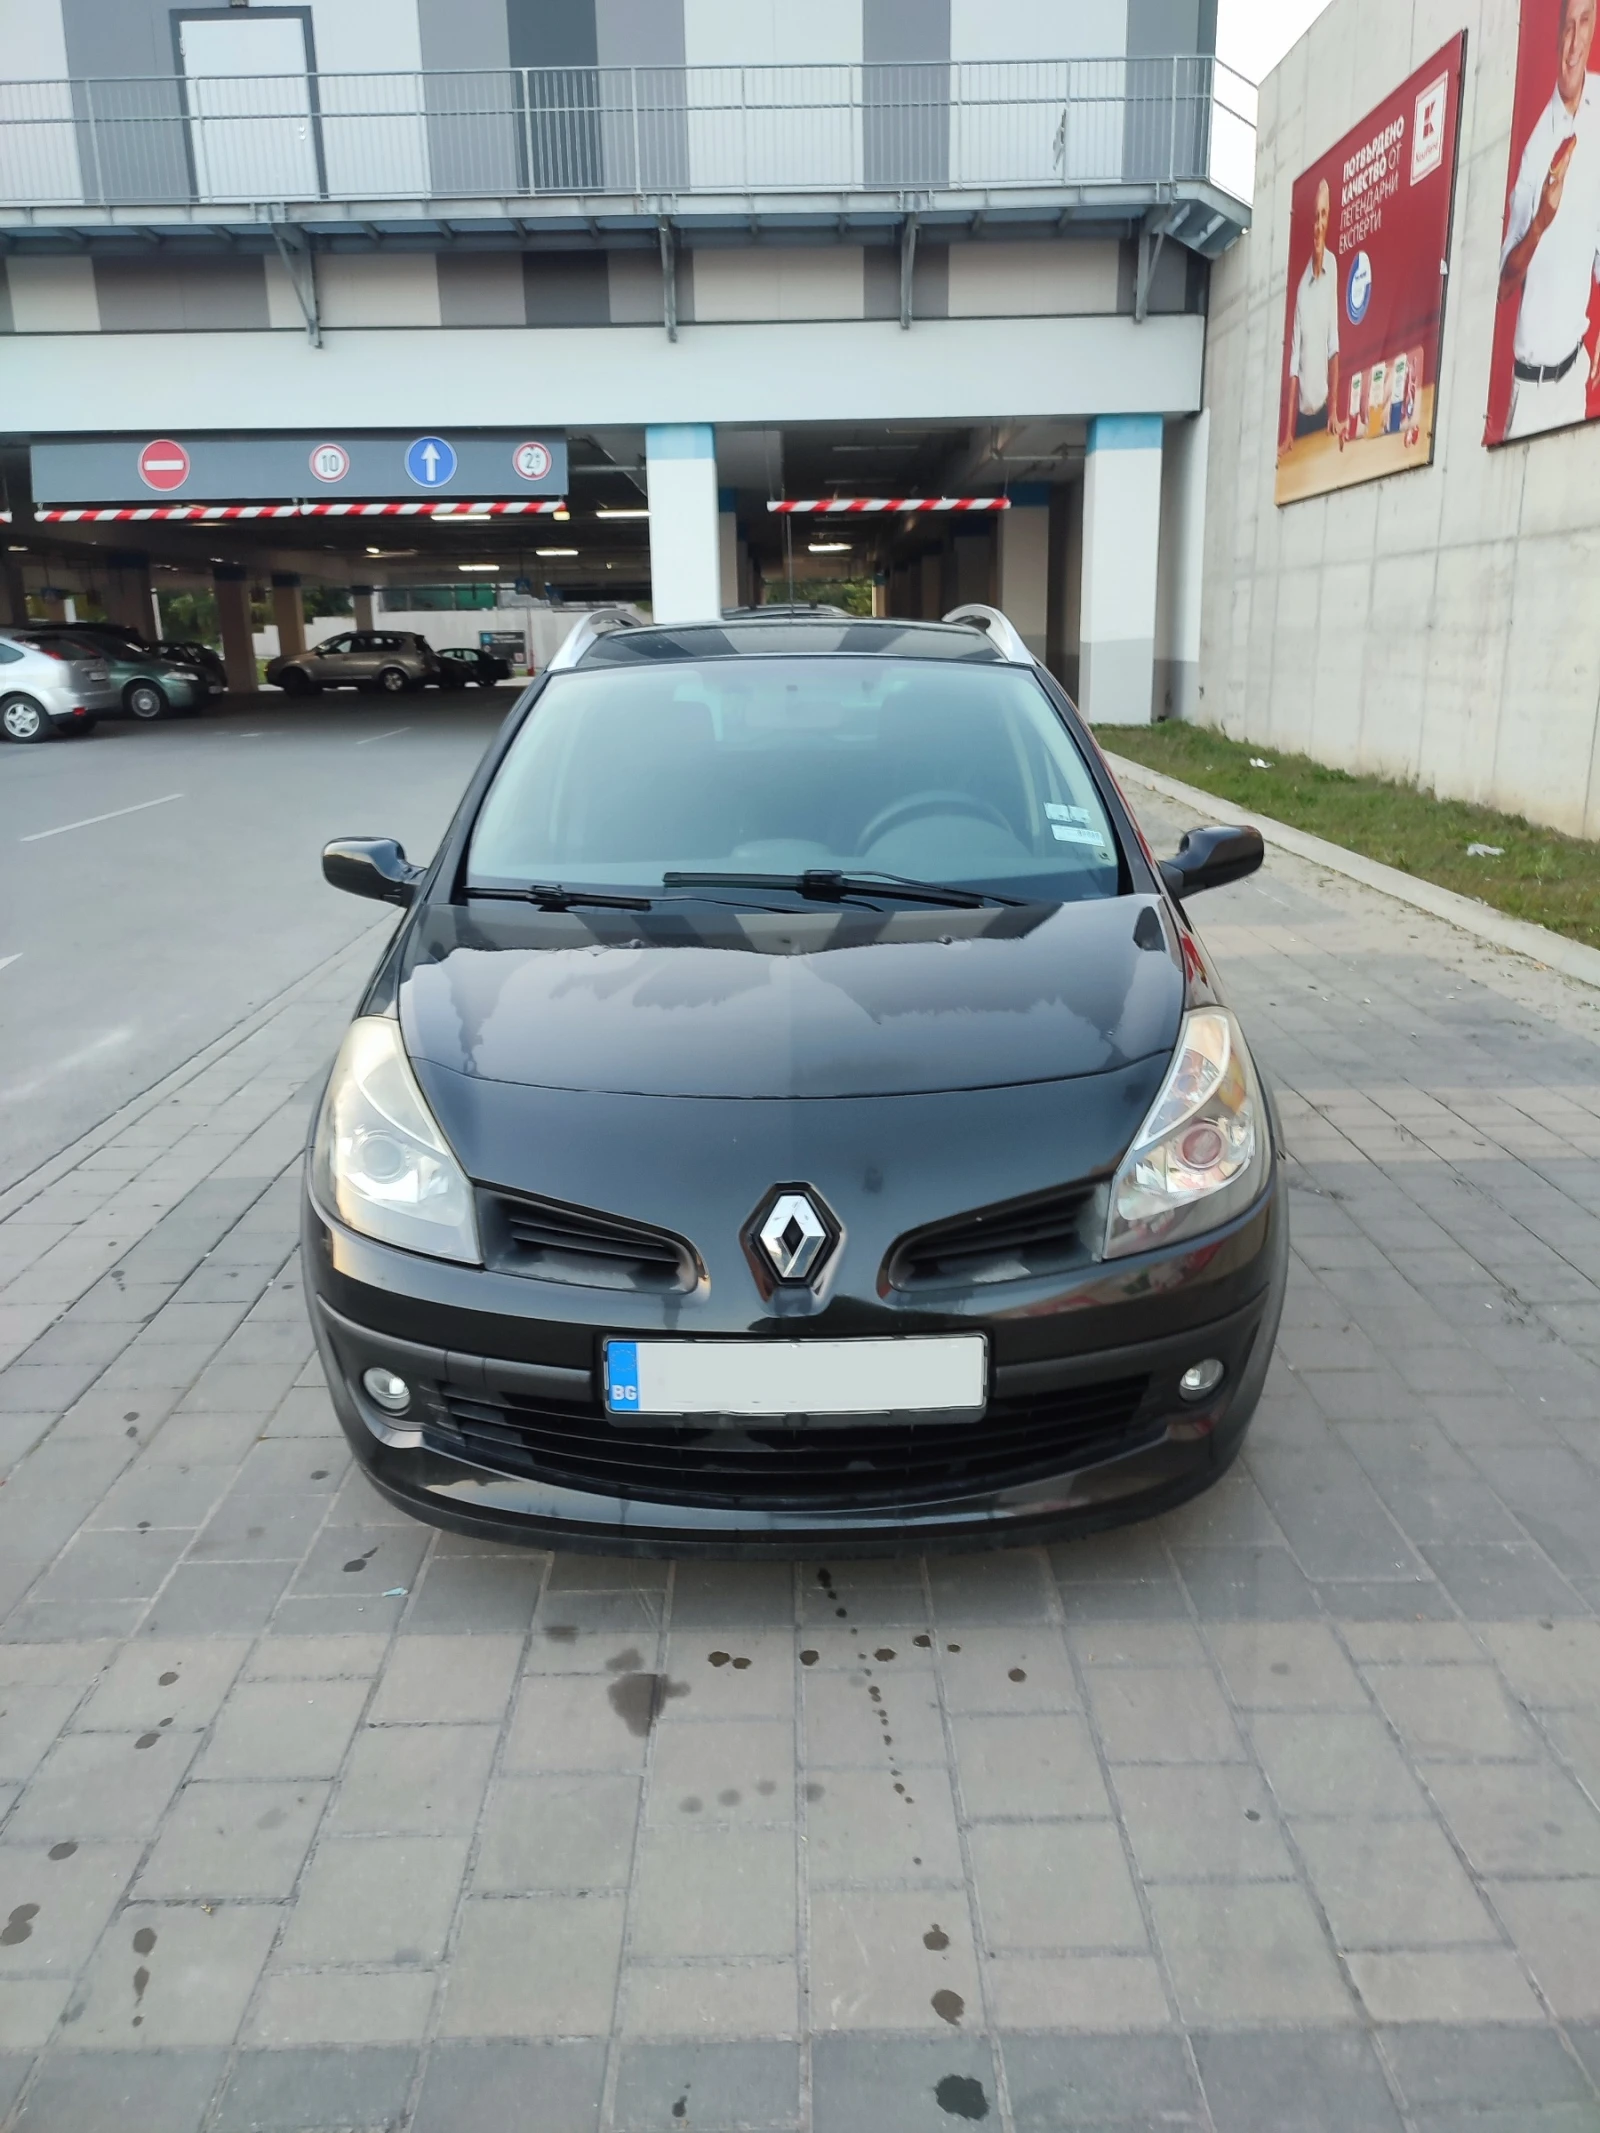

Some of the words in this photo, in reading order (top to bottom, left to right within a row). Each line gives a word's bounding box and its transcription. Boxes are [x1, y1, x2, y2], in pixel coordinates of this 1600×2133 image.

[1343, 115, 1405, 183] ПОТВЪРДЕНО
[1341, 155, 1387, 207] КАЧЕСТВО
[1388, 142, 1402, 170] ОТ
[1339, 207, 1382, 255] ЕКСПЕРТИ
[322, 454, 340, 472] 10
[611, 1384, 637, 1401] BG
